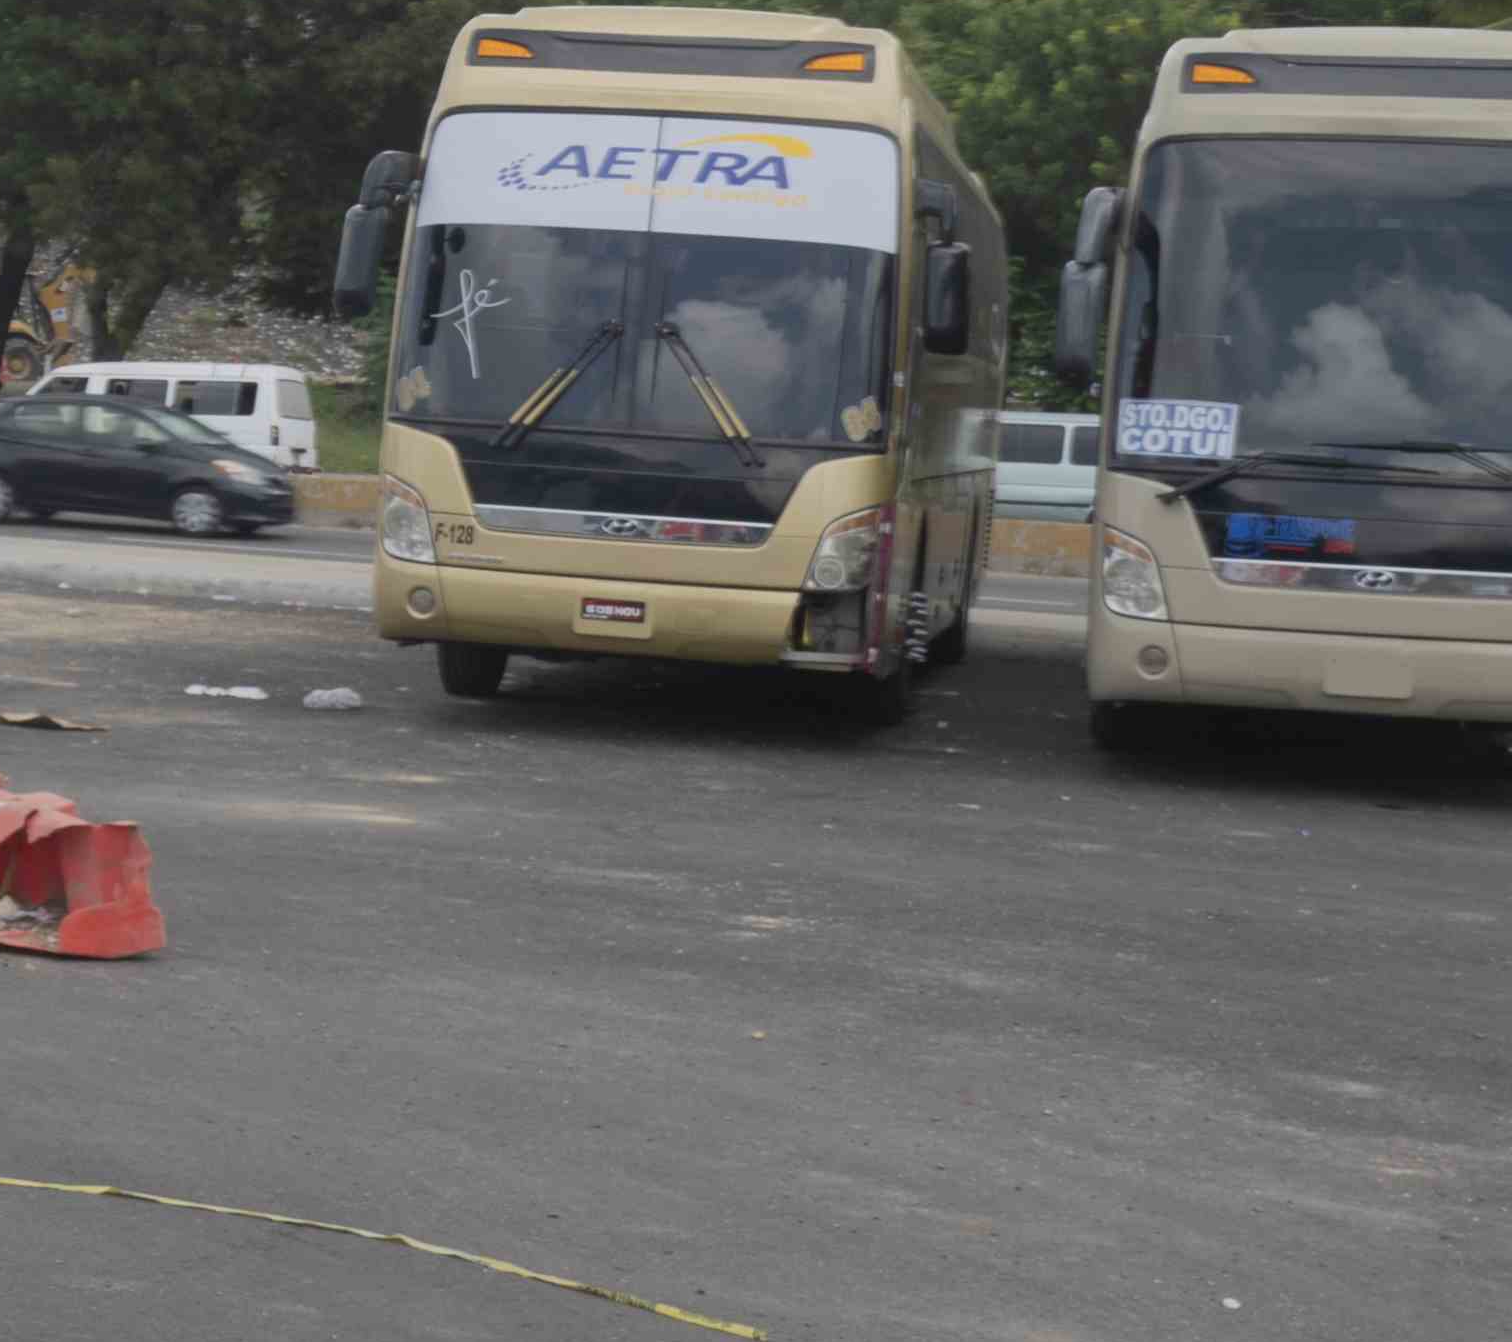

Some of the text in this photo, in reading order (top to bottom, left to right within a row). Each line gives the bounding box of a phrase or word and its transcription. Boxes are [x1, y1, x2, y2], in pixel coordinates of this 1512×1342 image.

[535, 144, 791, 190] AETRA
[1121, 428, 1233, 458] COTUI
[433, 522, 475, 545] F-128
